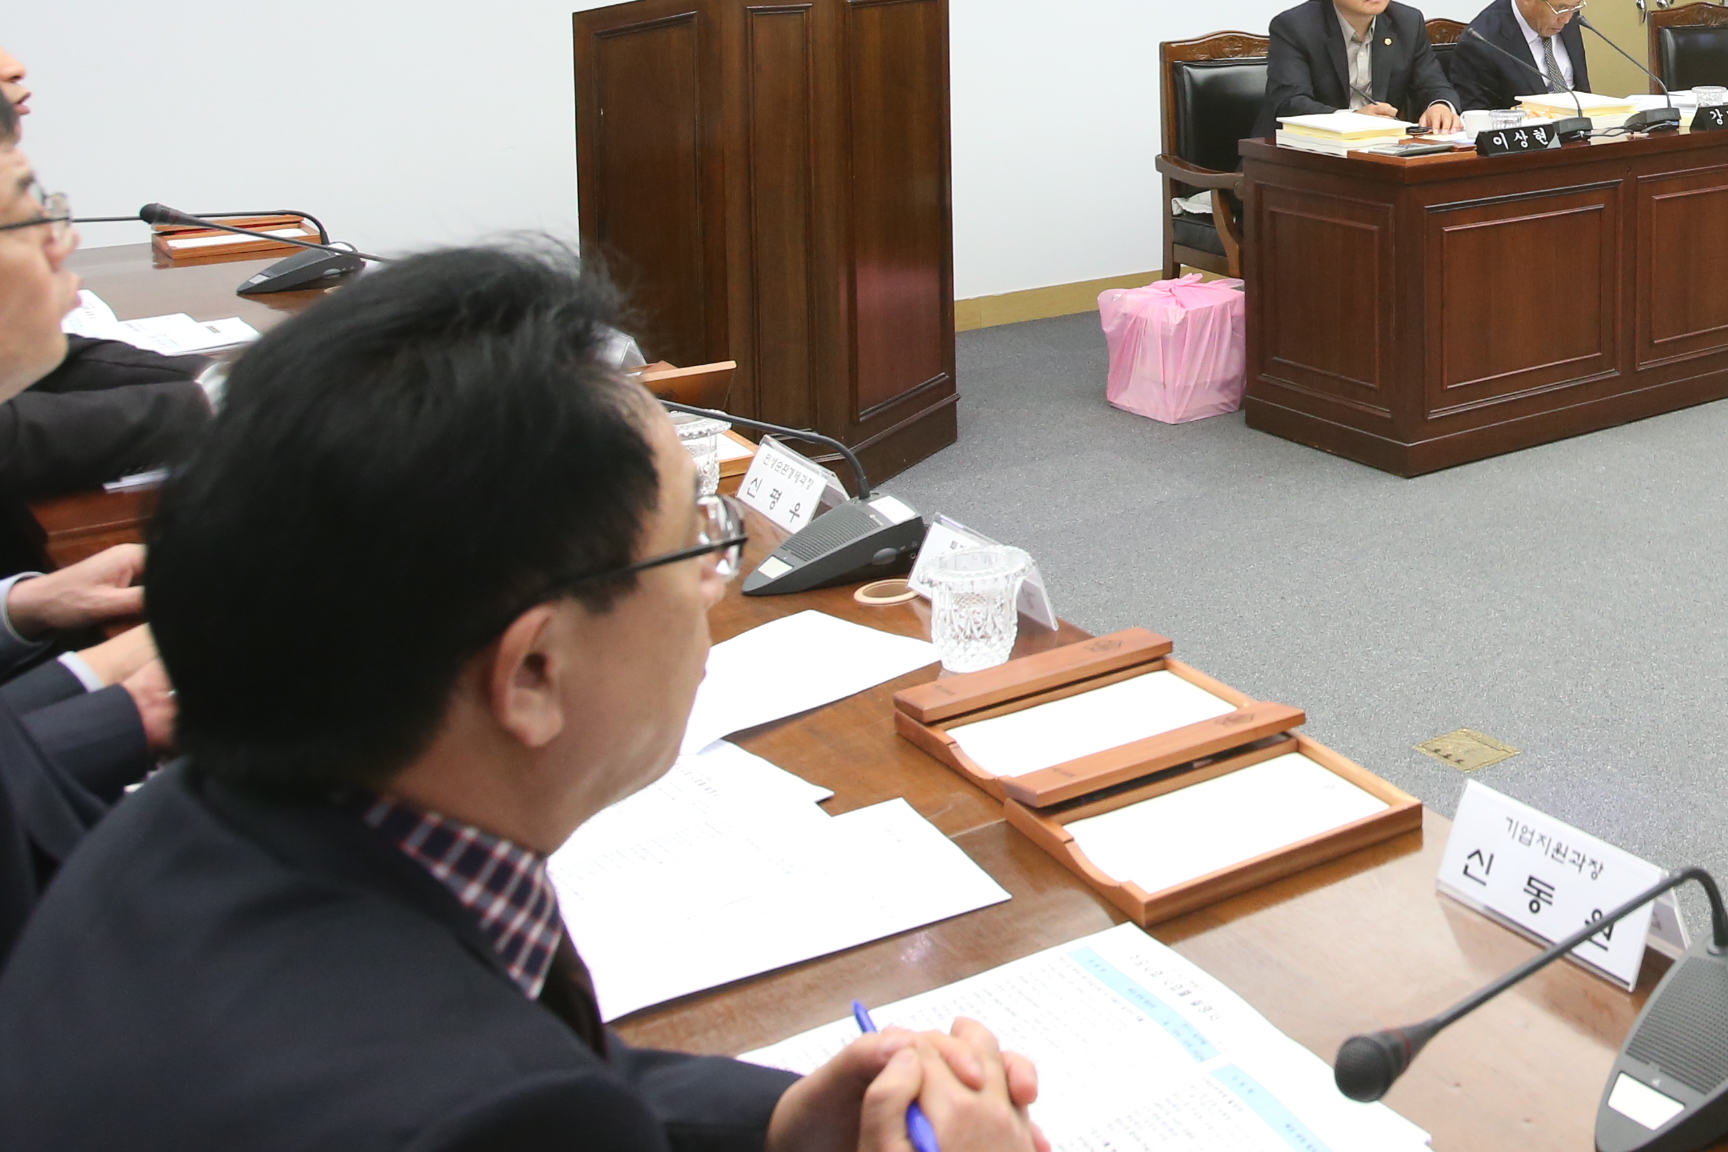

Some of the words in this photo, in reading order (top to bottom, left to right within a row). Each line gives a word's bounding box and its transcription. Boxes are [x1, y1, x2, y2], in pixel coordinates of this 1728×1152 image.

[1492, 126, 1550, 150] 이상현
[746, 477, 801, 524] 신평우
[1506, 816, 1604, 881] 기업지원과장
